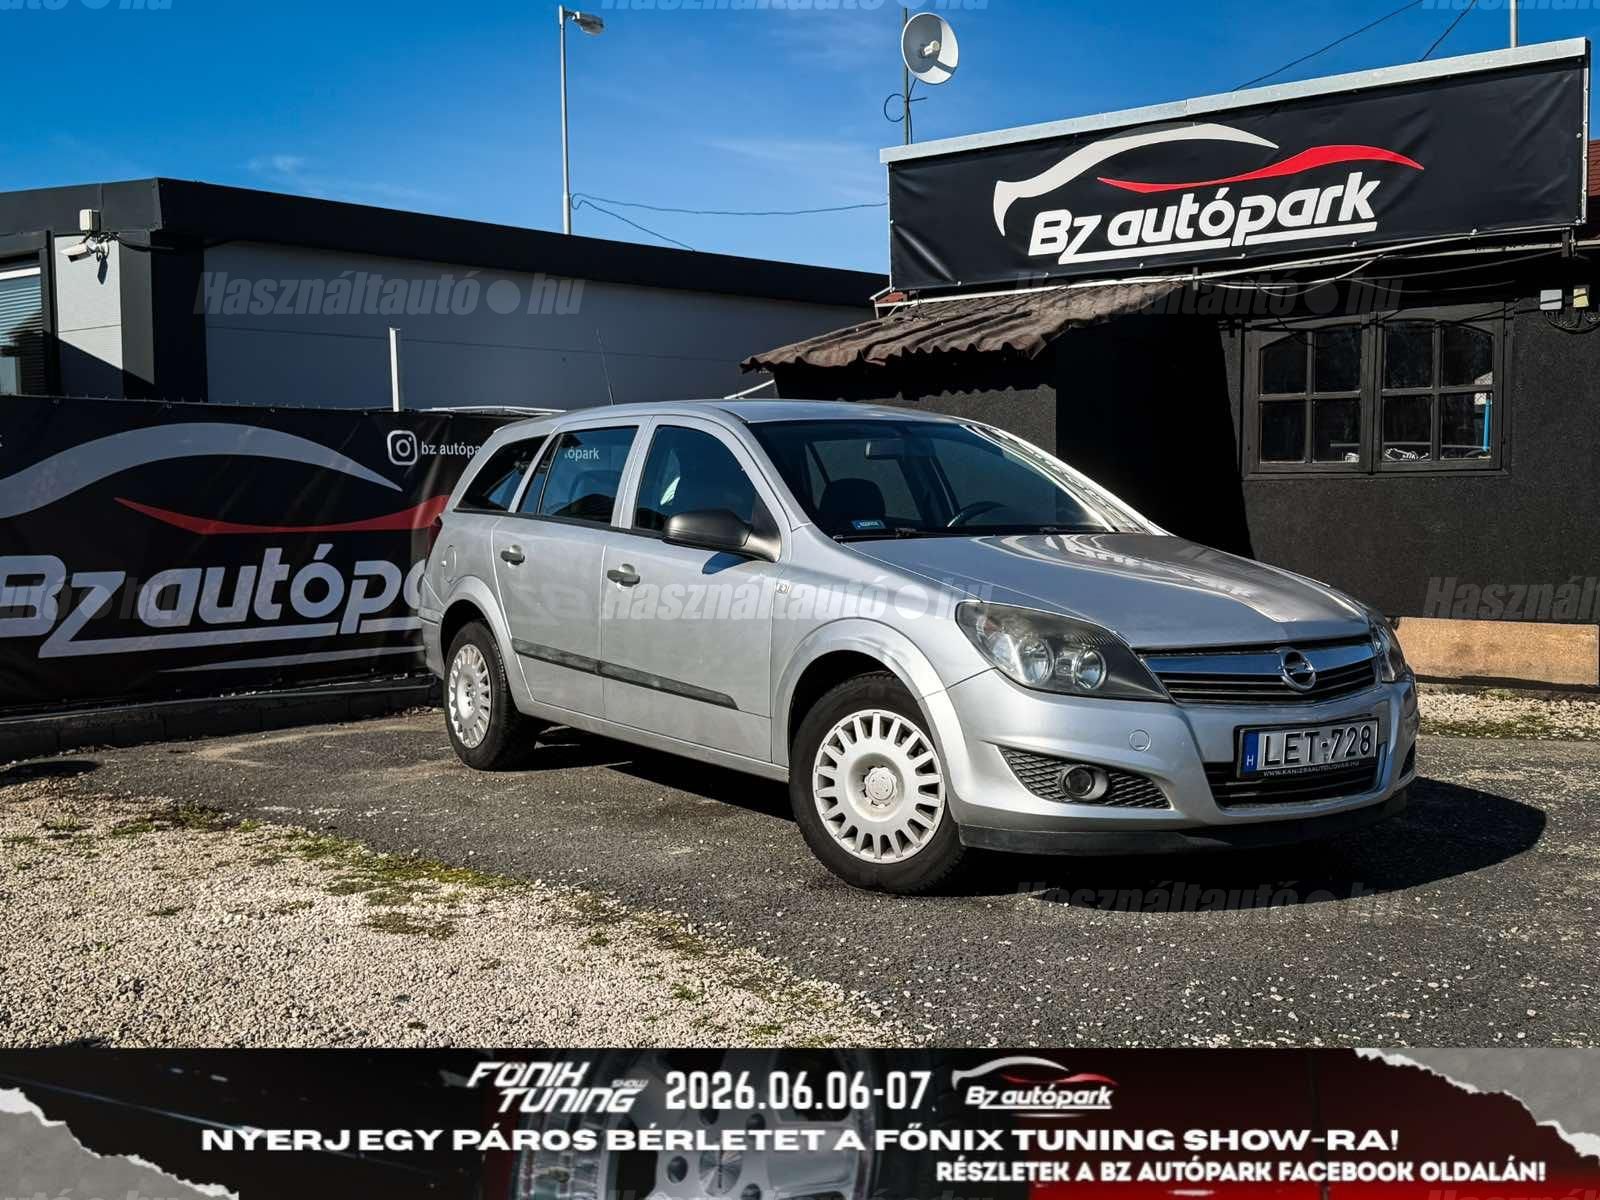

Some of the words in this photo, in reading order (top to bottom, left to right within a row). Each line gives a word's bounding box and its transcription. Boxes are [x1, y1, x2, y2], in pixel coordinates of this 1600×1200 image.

[1028, 208, 1102, 265] Bz
[1107, 171, 1381, 247] autópark
[421, 442, 436, 455] bz
[564, 448, 600, 461] ópark
[0, 554, 126, 658] Bz
[1246, 755, 1254, 767] H
[1262, 725, 1371, 767] LET-728
